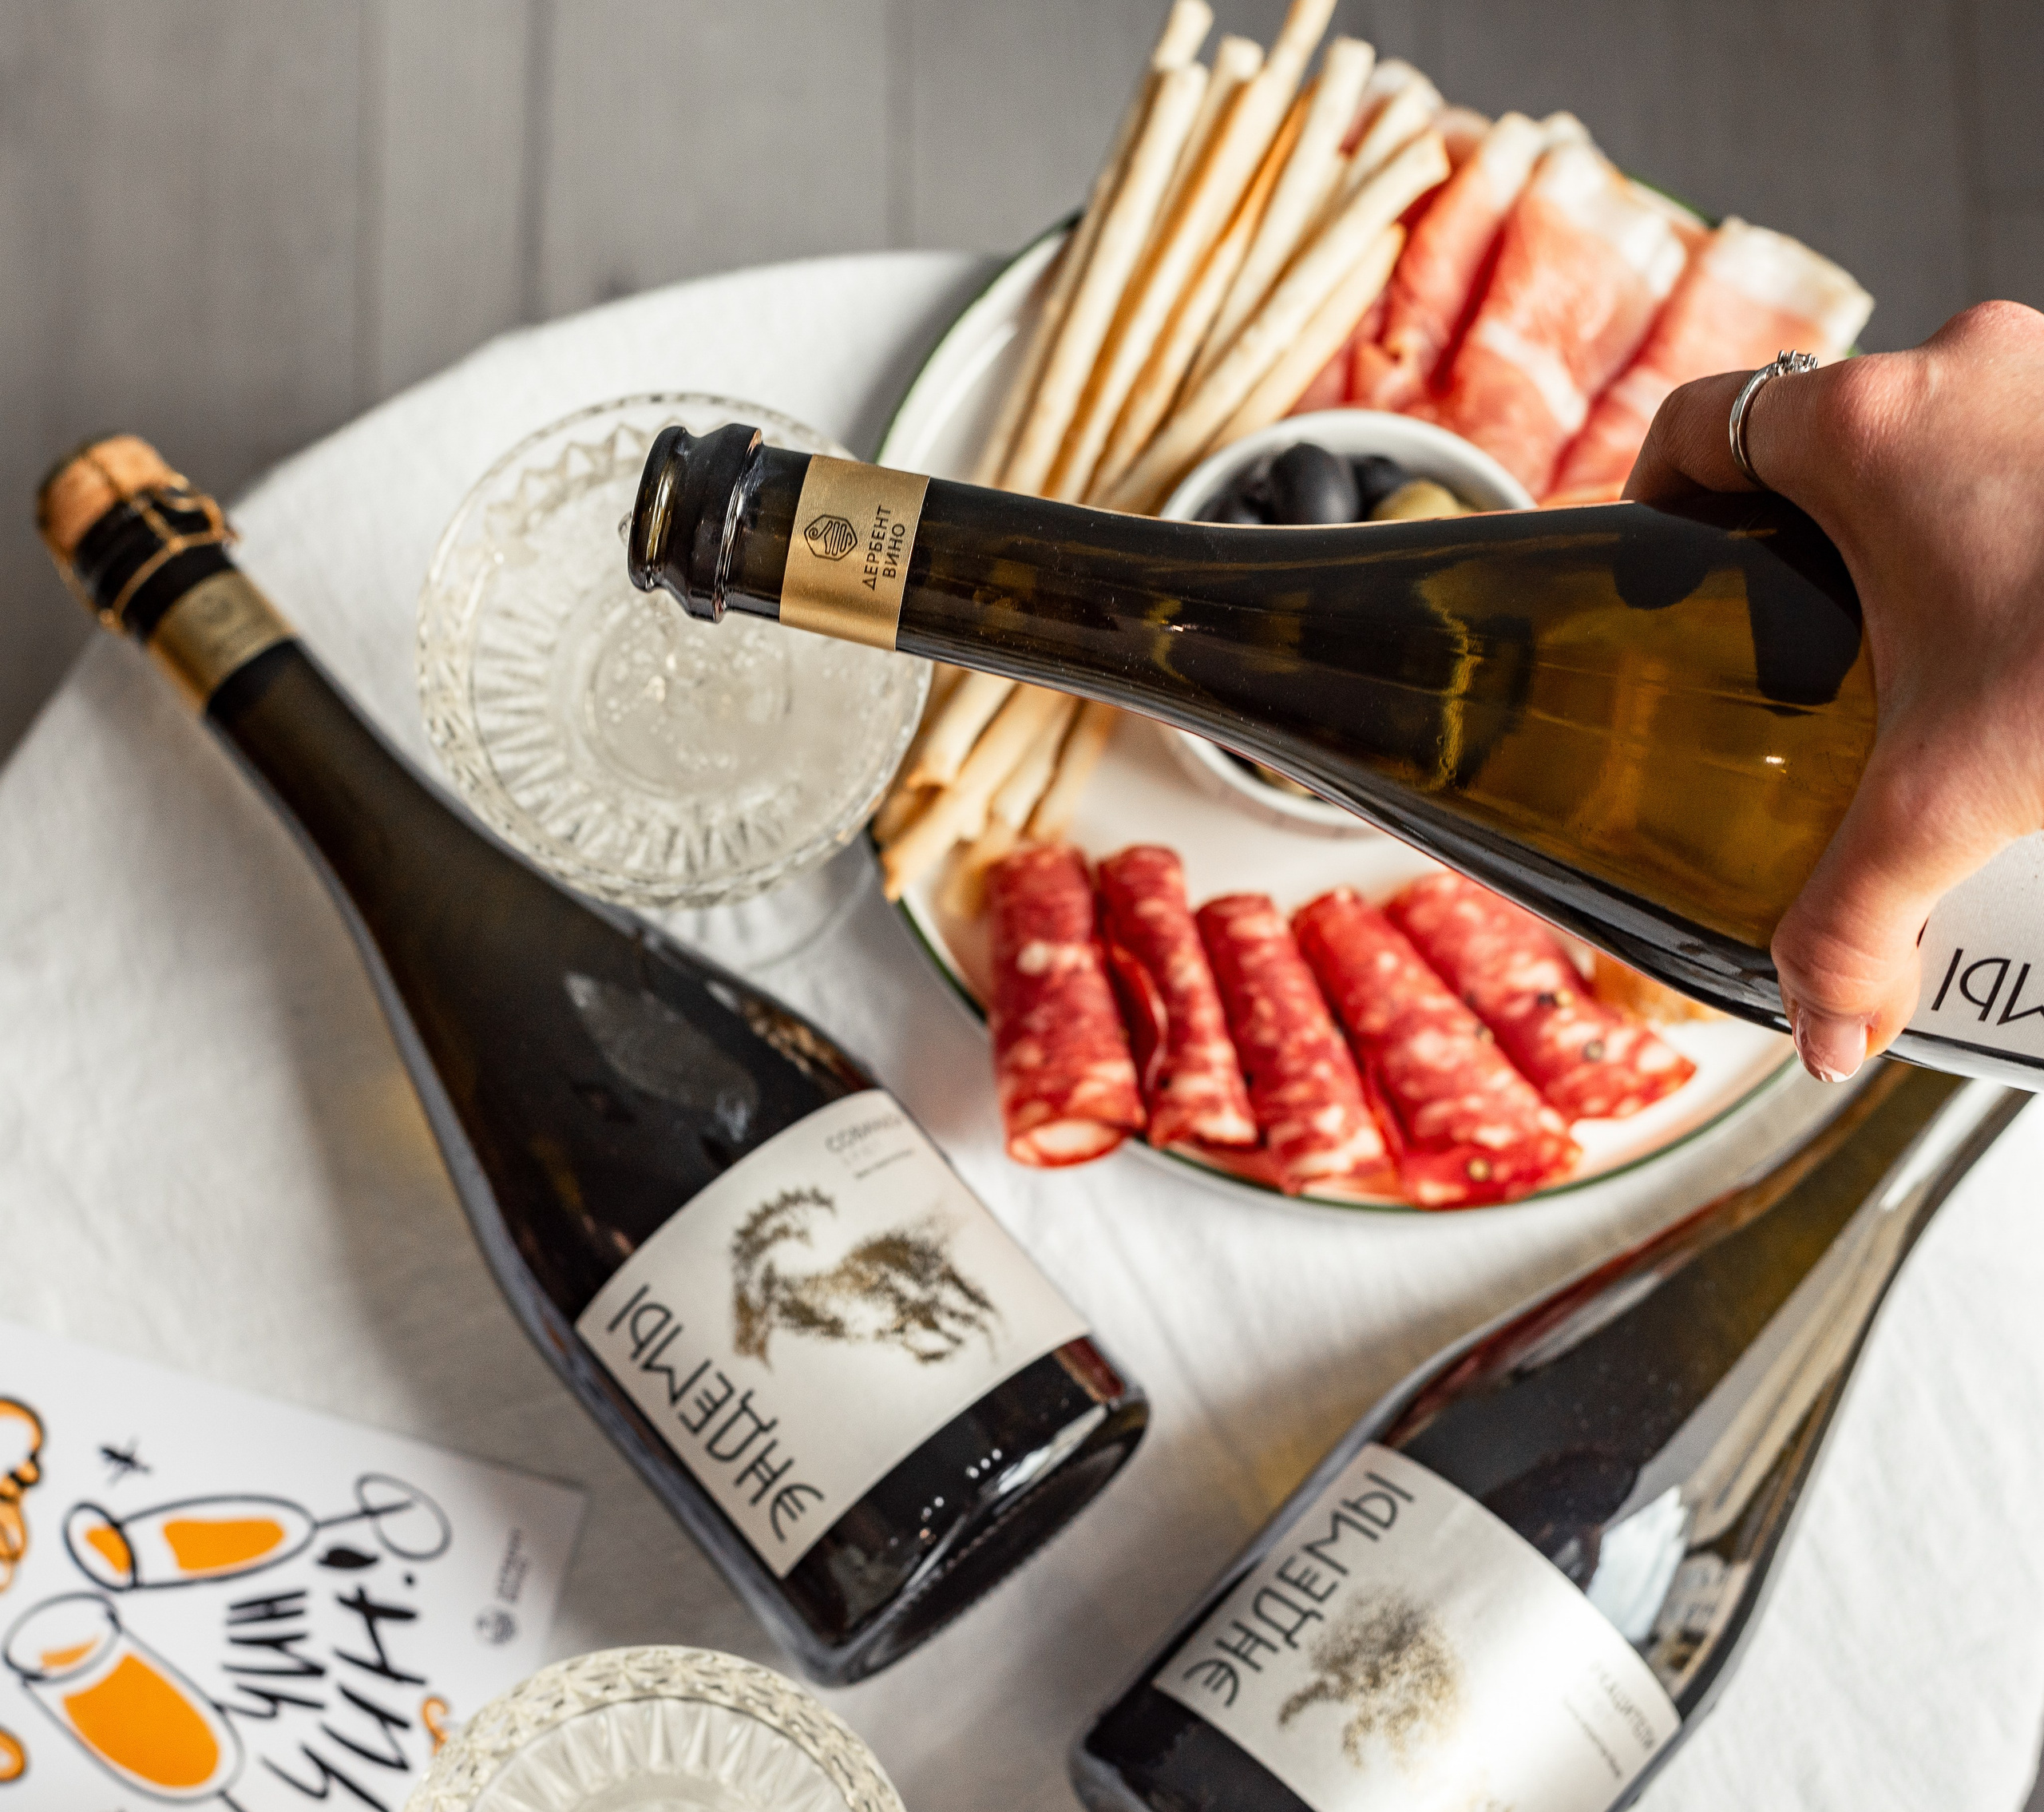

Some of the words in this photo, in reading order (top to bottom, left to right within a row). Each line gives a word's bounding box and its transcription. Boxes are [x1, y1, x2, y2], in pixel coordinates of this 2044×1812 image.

[862, 505, 891, 592] ДЕРБЕНТ
[882, 523, 905, 579] ВИНО
[608, 1285, 826, 1543] ЭНДЕМЫ
[1185, 1471, 1416, 1708] ЭНДЕМЫ
